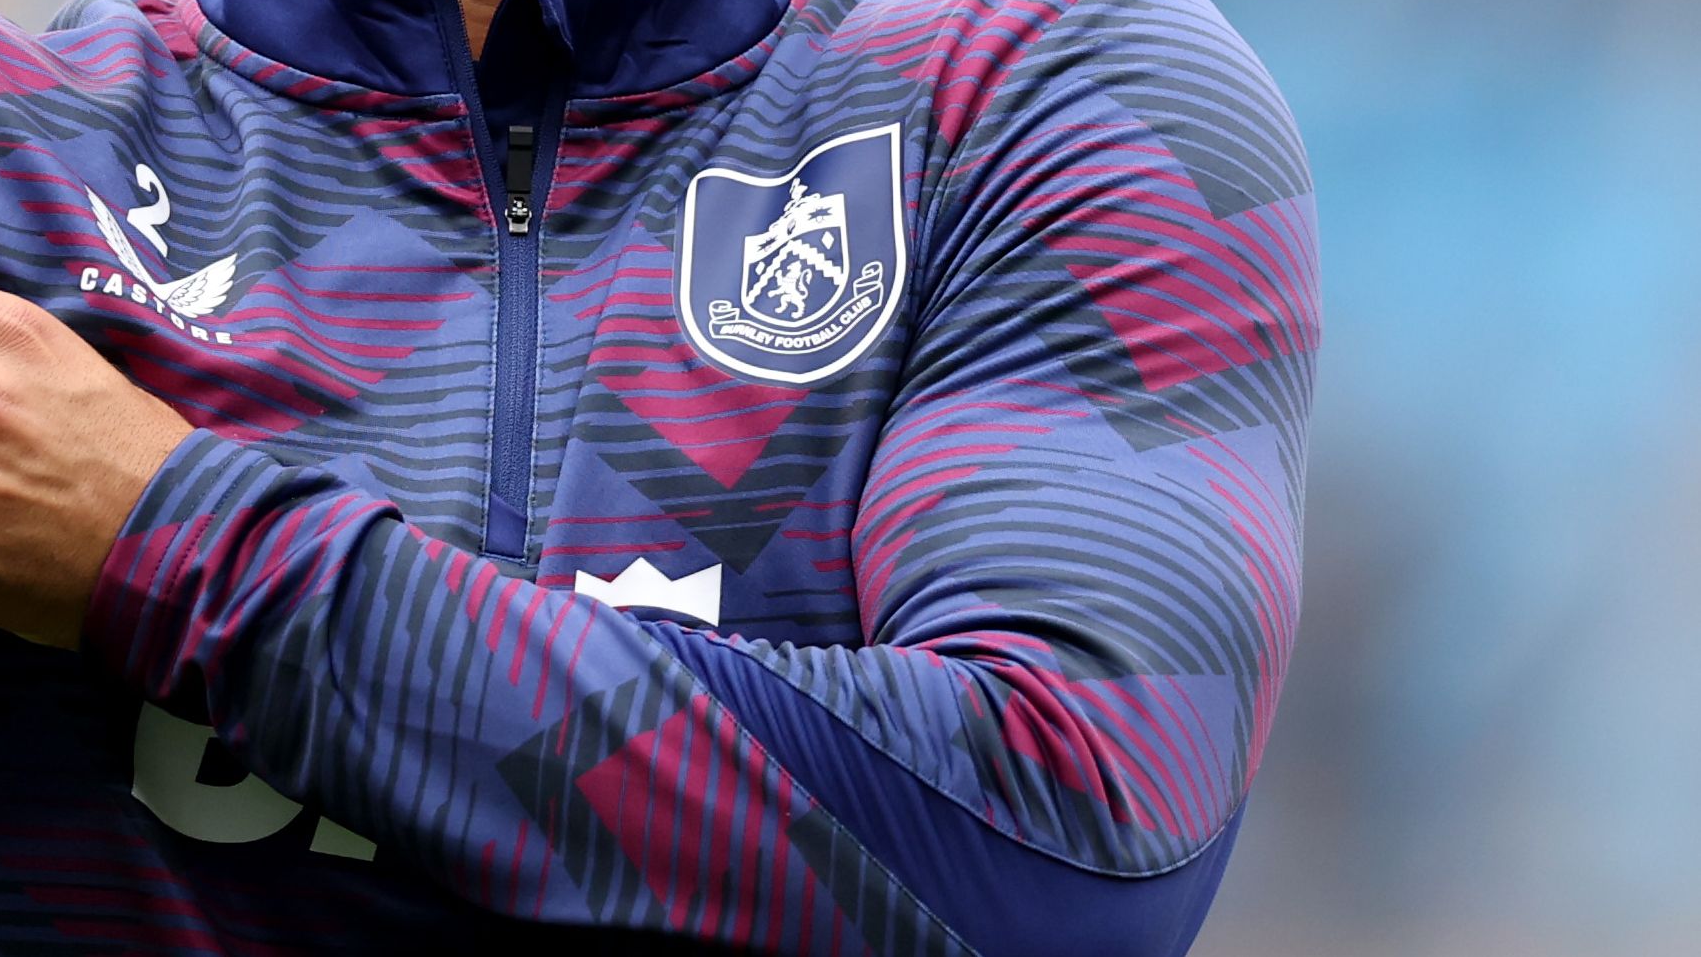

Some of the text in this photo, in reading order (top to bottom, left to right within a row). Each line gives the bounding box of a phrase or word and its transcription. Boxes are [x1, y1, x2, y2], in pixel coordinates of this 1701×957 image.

[127, 163, 171, 258] 2
[80, 267, 233, 345] CASTORE
[719, 296, 873, 349] BURNLEY FOOTBALL CLUB
